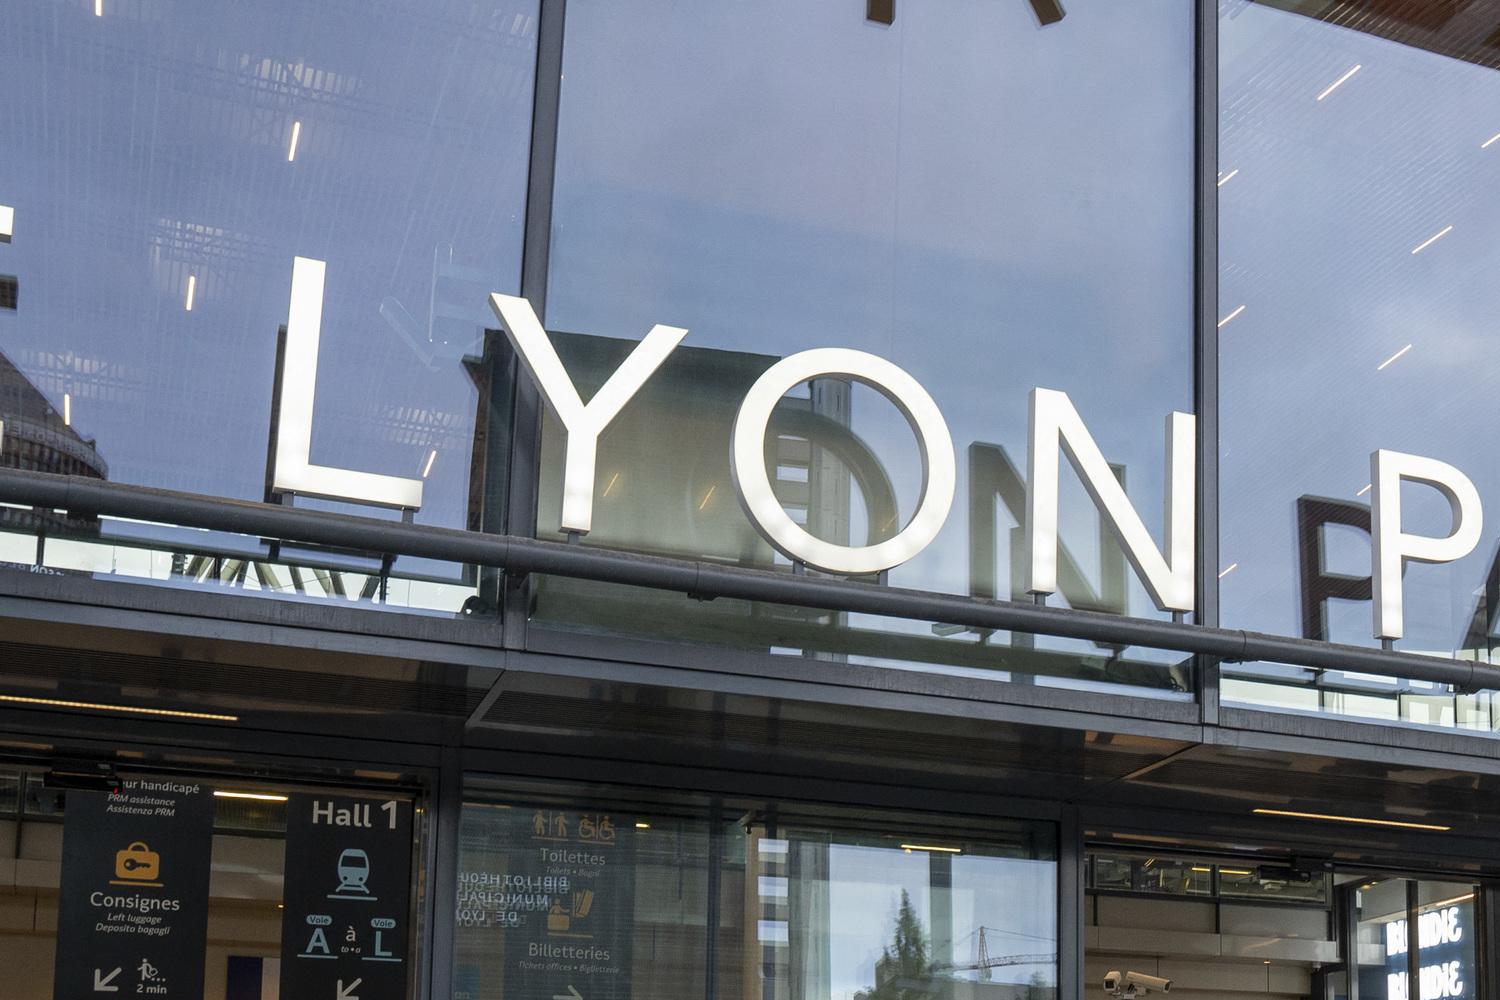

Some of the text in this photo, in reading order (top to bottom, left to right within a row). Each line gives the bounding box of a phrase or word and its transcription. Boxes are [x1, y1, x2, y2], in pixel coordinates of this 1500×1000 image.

[273, 255, 1198, 613] LYON
[141, 780, 200, 796] handicapé
[130, 796, 176, 807] assistance
[106, 805, 176, 817] Assistenza PRM
[312, 800, 398, 830] Hall 1
[540, 848, 606, 866] Toilettes
[90, 891, 180, 913] Consignes
[107, 913, 163, 925] Left luggage
[309, 917, 329, 925] Voie
[373, 920, 393, 928] Voie
[95, 923, 171, 936] Deposito bagagli
[1386, 906, 1463, 956] BLNDIE
[305, 926, 393, 957] A à L
[528, 942, 611, 961] Billetteries
[136, 983, 168, 995] 2 min
